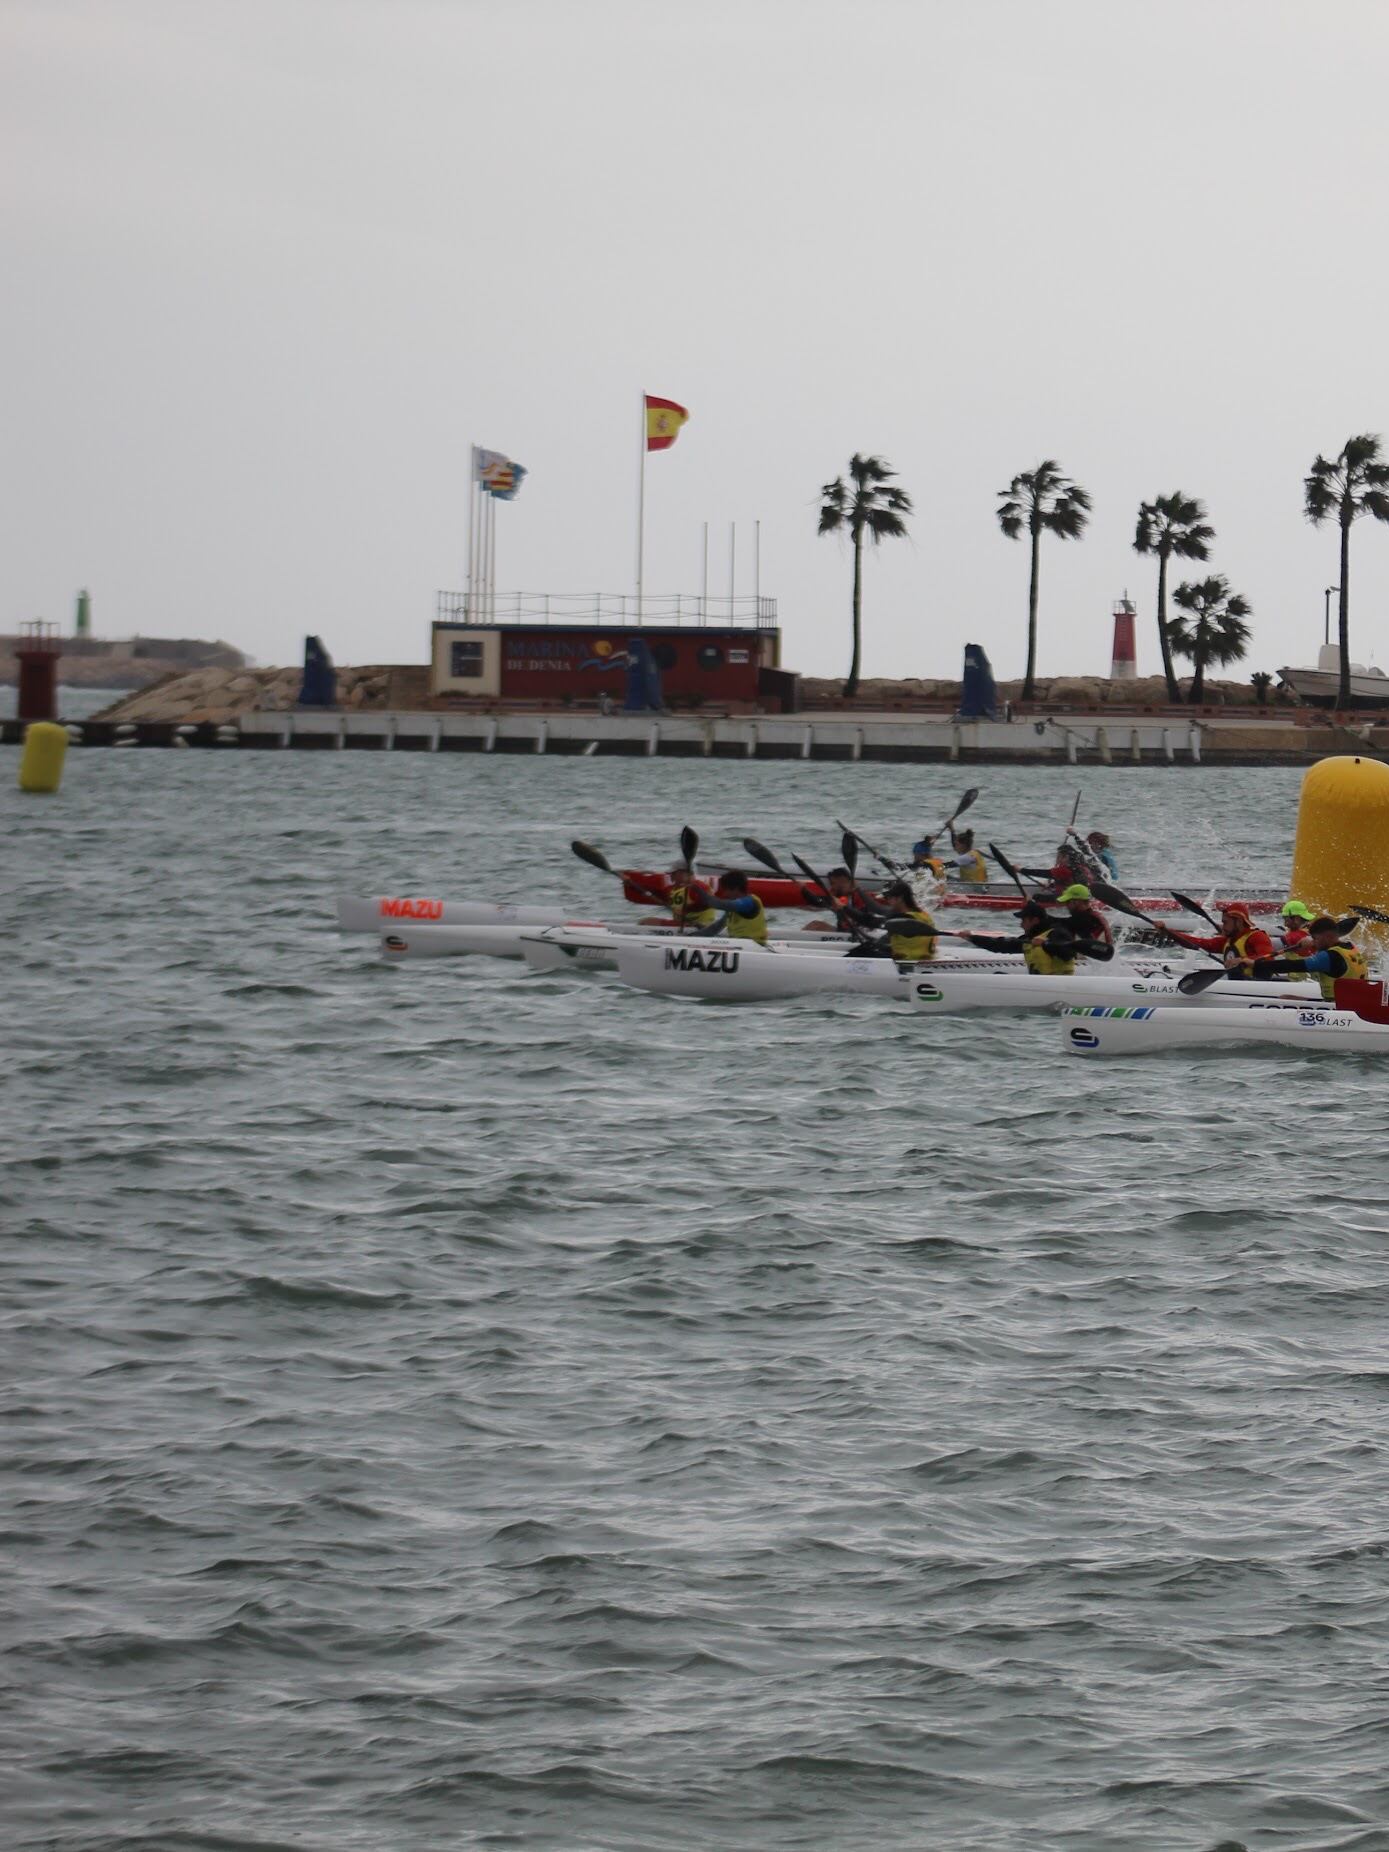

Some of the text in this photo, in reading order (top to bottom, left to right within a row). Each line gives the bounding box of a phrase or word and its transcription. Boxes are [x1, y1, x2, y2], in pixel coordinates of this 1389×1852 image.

[507, 640, 589, 657] MARINA
[507, 660, 525, 670] DE
[380, 897, 443, 920] MAZU
[665, 947, 739, 974] MAZU
[1300, 1012, 1324, 1022] 136
